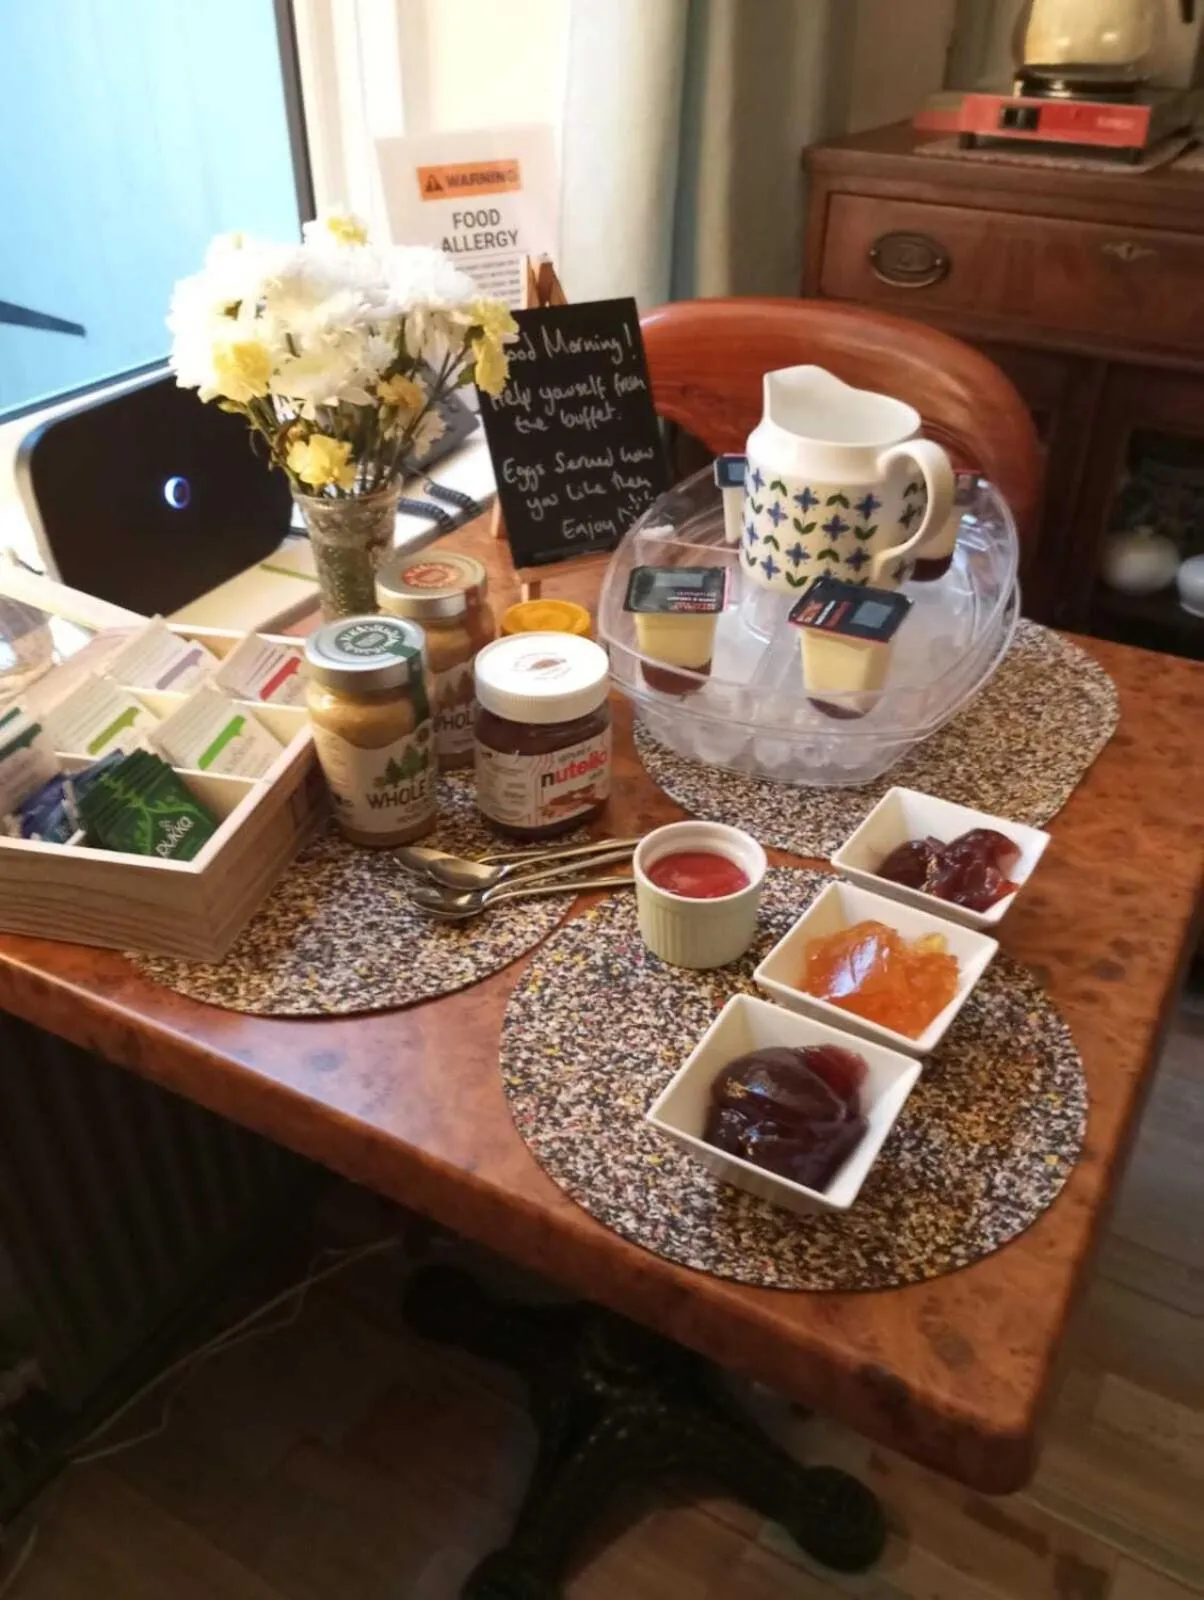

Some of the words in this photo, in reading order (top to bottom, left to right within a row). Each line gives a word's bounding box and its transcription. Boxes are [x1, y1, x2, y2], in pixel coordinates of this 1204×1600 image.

[452, 208, 501, 230] FOOD
[442, 229, 518, 253] ALLERGY
[504, 332, 536, 361] ood
[538, 375, 607, 416] yourself
[614, 372, 647, 397] from
[515, 415, 549, 434] the
[503, 457, 546, 492] Eggs
[620, 446, 654, 463] how
[526, 493, 559, 521] you
[562, 518, 617, 540] Enjoy
[432, 706, 476, 733] WHOL
[541, 750, 607, 788] nutella
[366, 778, 427, 809] WHOLE
